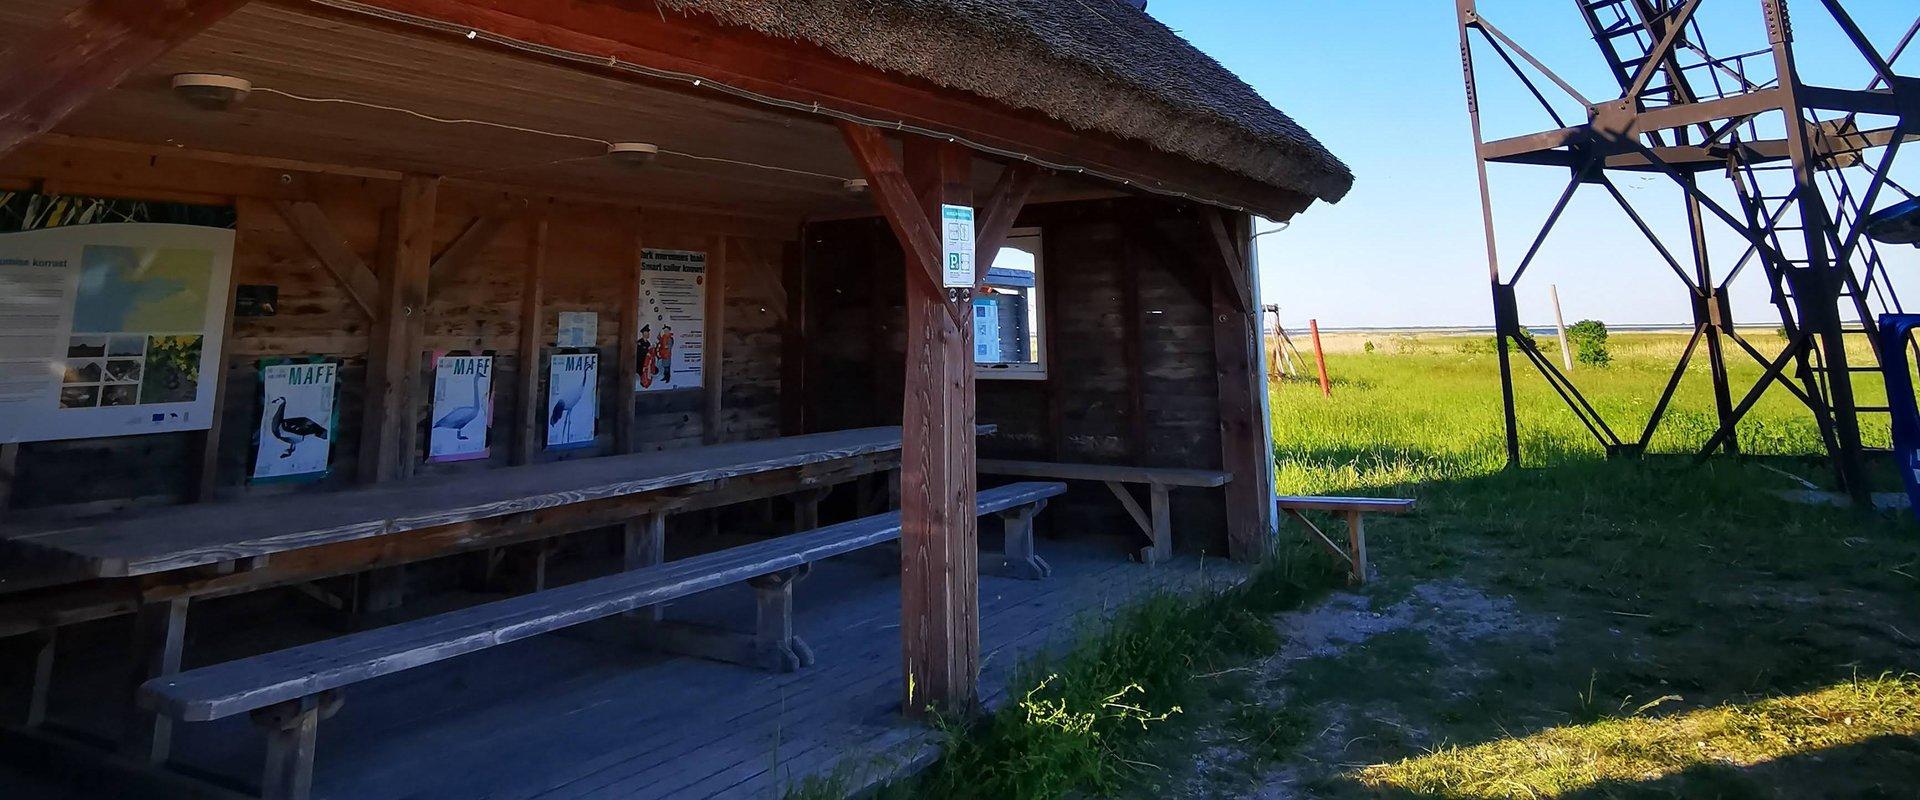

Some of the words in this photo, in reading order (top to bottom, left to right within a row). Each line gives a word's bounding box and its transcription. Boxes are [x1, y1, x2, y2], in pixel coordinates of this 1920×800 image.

[641, 262, 662, 271] Smart
[453, 358, 490, 375] MAFF
[565, 356, 596, 371] MAFF
[288, 365, 334, 385] MAFF
